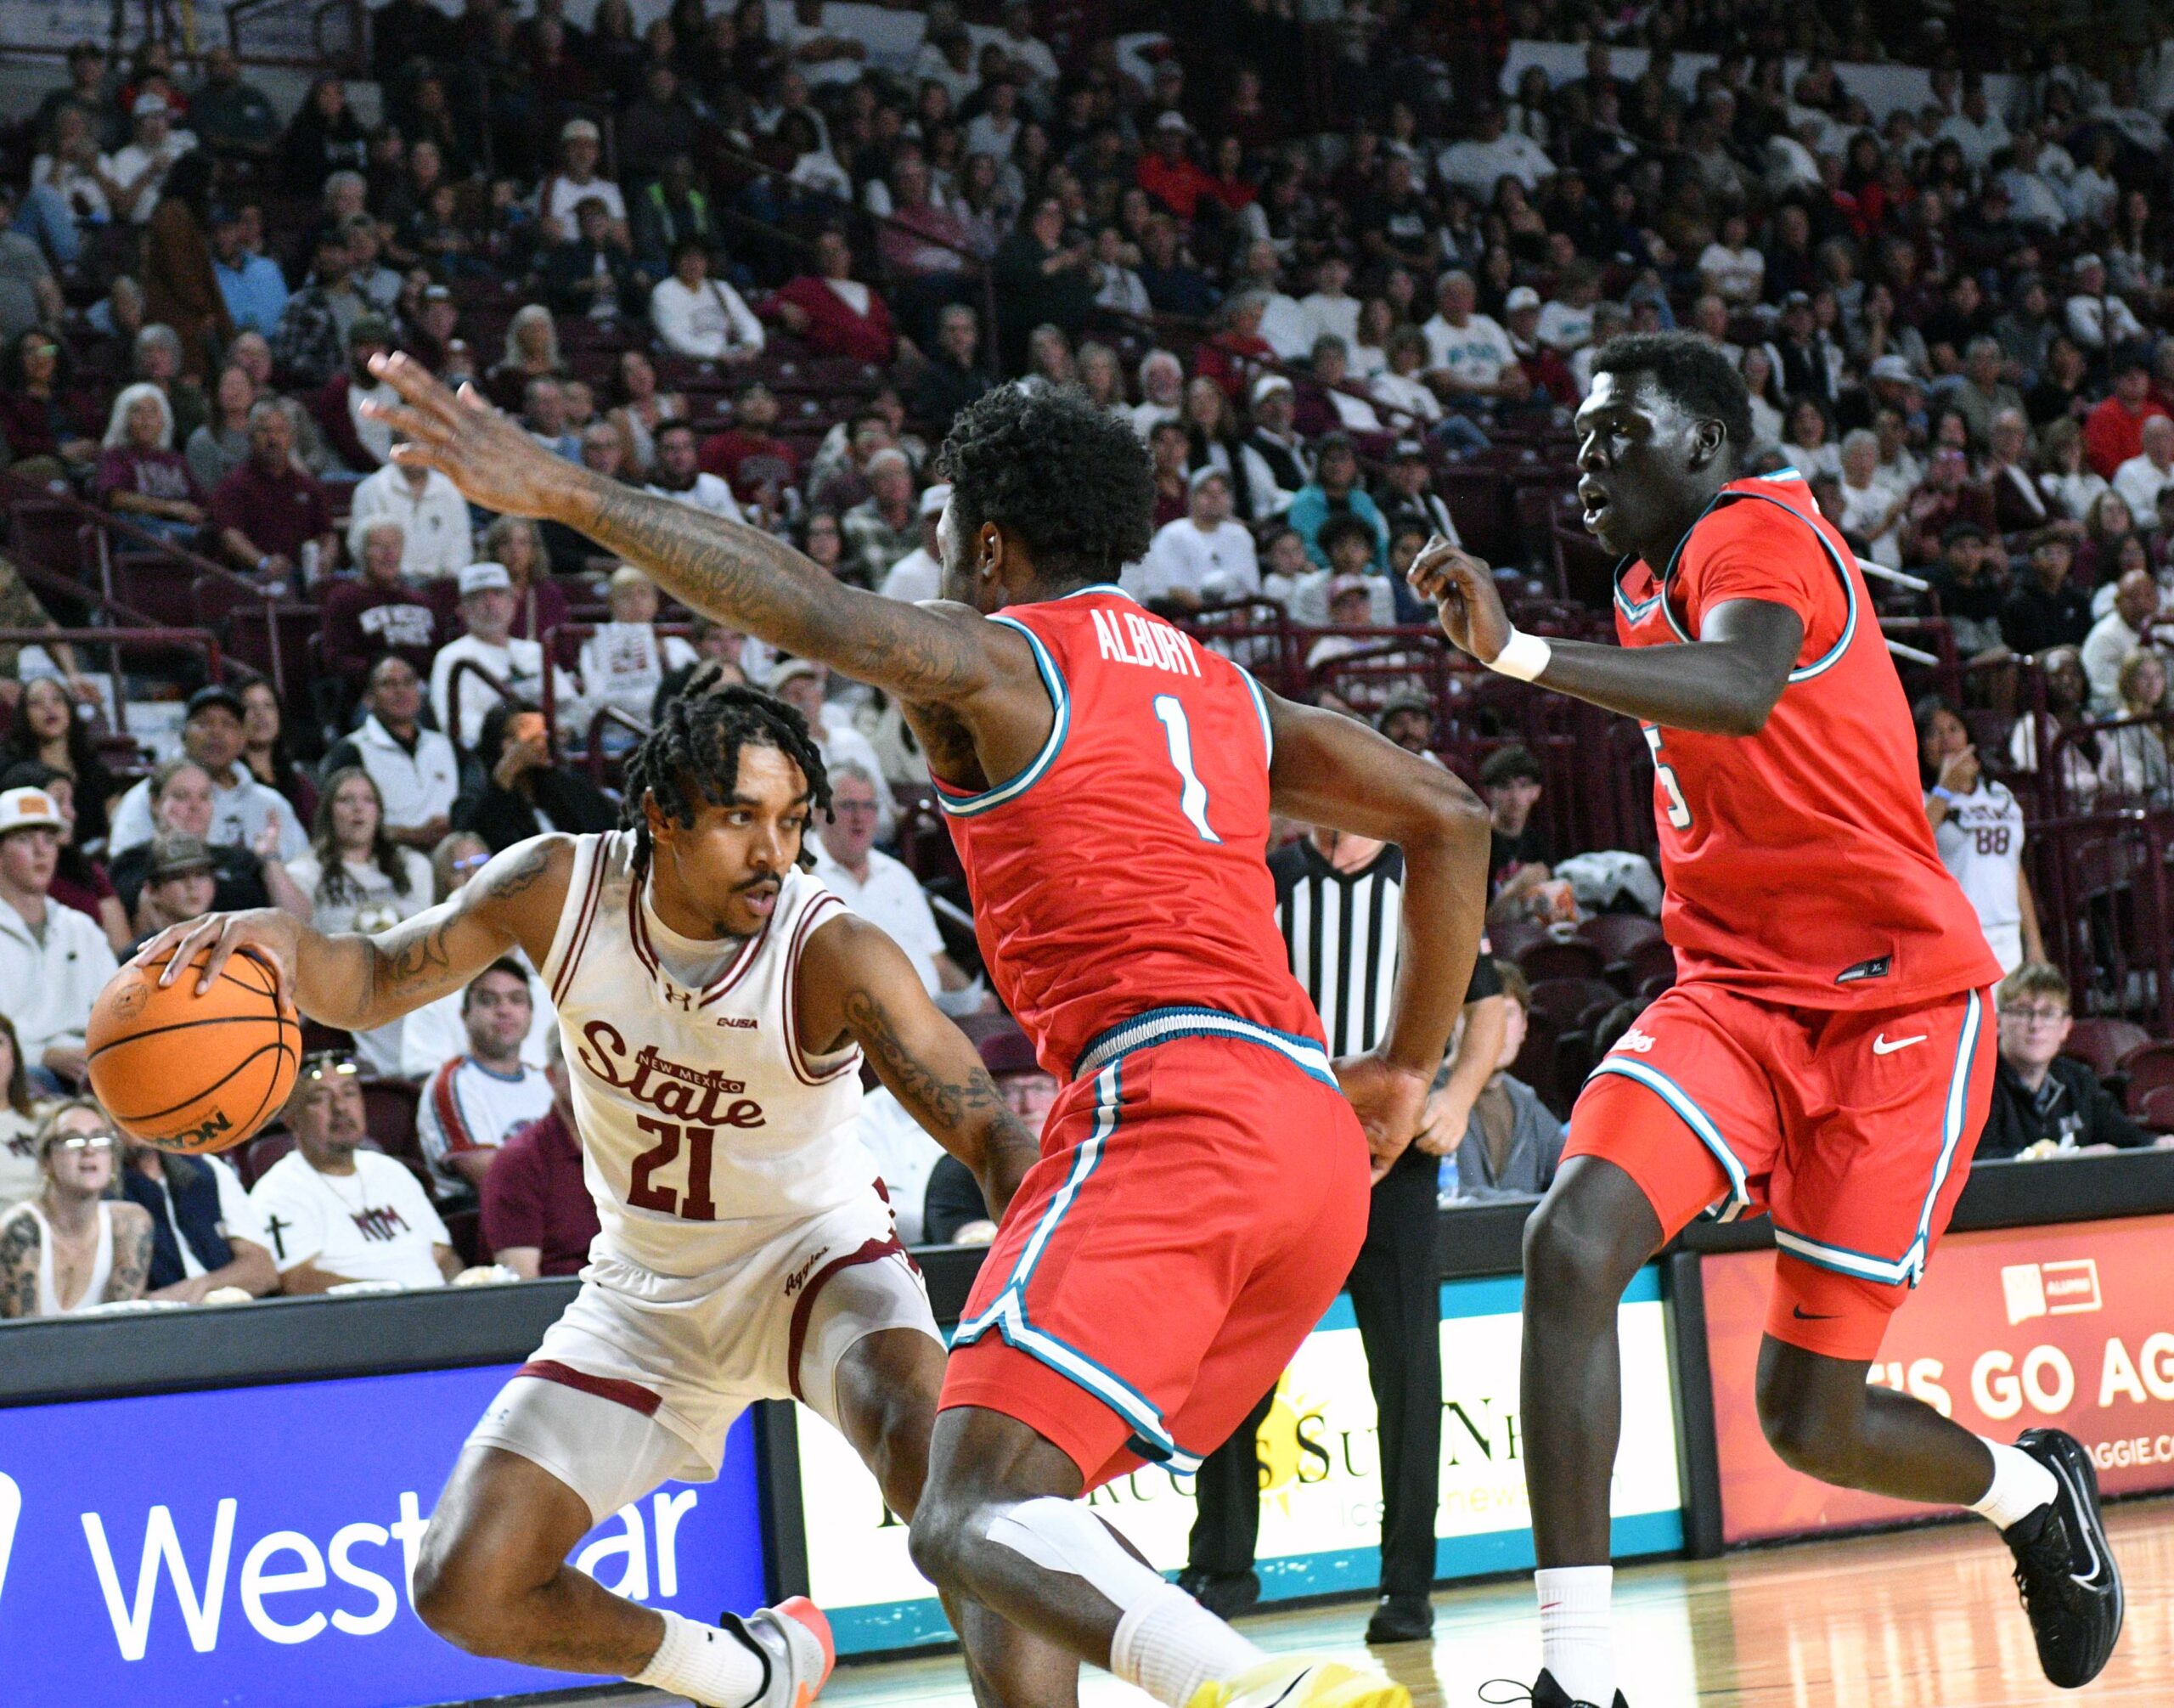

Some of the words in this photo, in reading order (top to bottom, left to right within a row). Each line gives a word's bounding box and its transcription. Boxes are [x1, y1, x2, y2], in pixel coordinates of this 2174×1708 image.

[1090, 609, 1202, 677] ALBURY
[1152, 693, 1224, 844] 1
[1975, 826, 2010, 854] 88
[578, 1020, 766, 1128] State
[639, 1053, 672, 1074] NEW
[680, 1068, 741, 1092] MEXICO
[627, 1114, 716, 1220] 21
[785, 1246, 830, 1296] Aggies
[1971, 1344, 2075, 1420] GO
